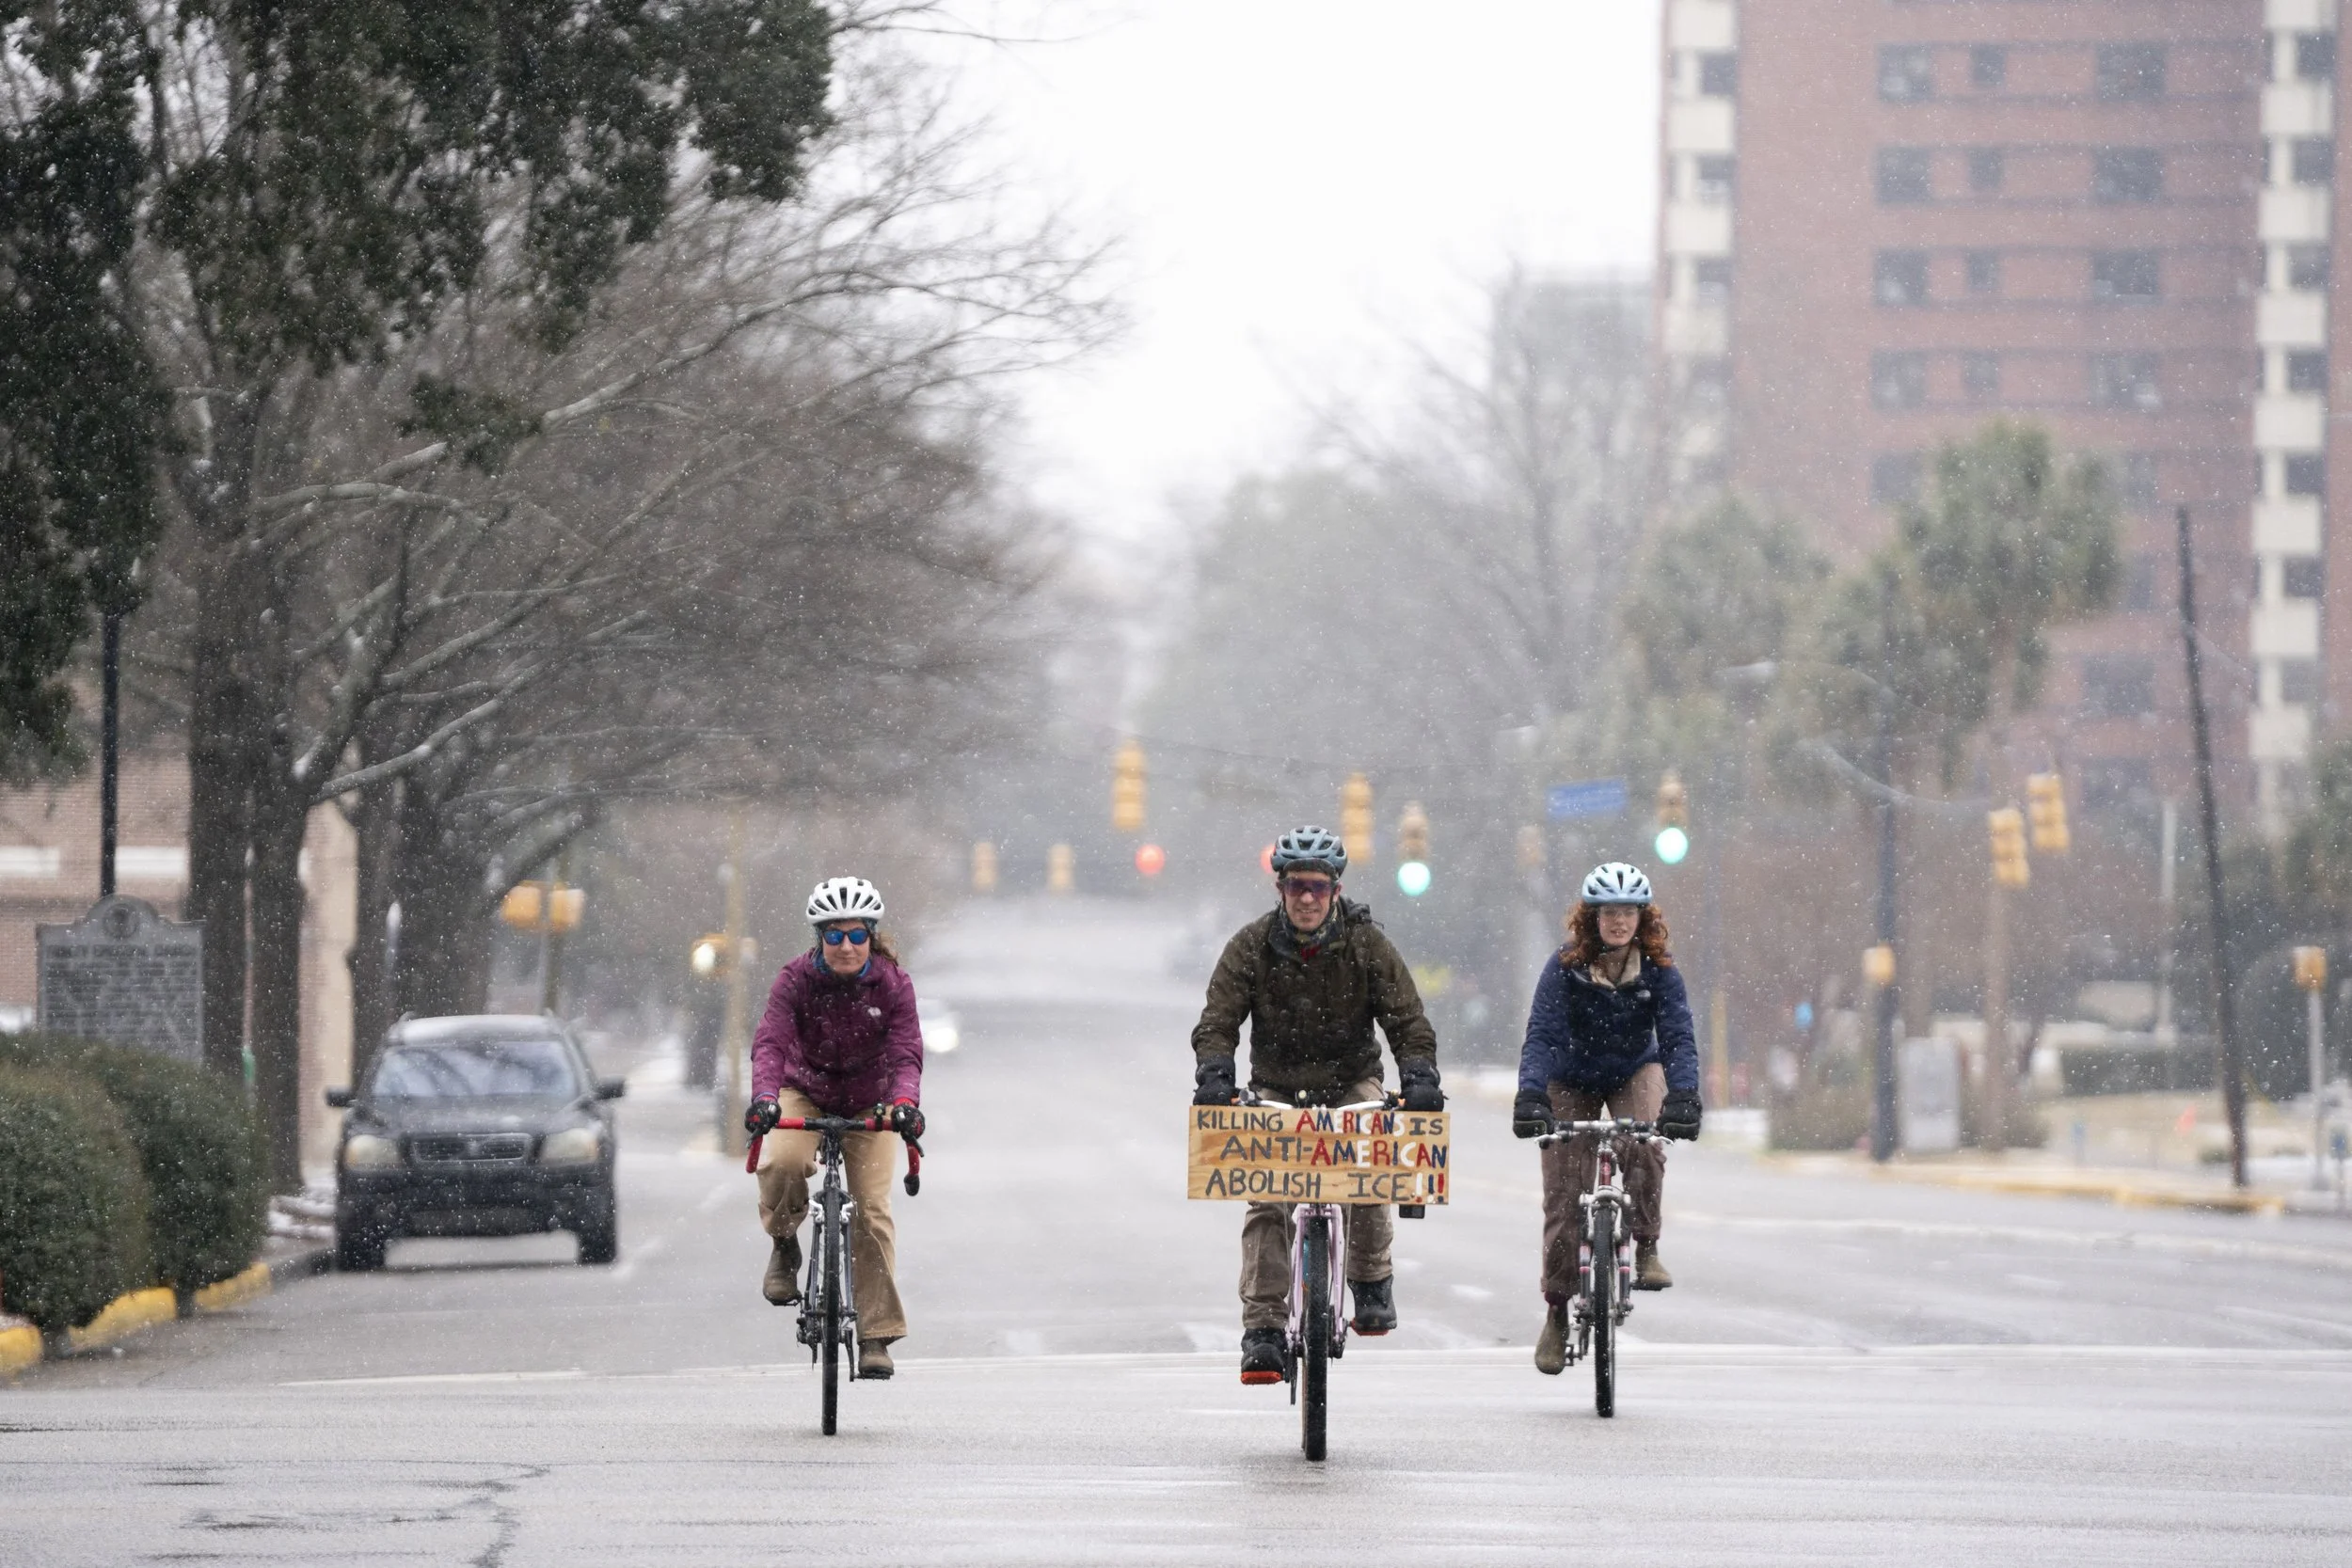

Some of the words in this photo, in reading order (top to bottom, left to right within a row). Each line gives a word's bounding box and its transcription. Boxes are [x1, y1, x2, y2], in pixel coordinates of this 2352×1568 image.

[1197, 1110, 1283, 1132] KILLING
[1295, 1110, 1405, 1136] AMERICANS
[1408, 1117, 1444, 1135] IS
[1220, 1135, 1447, 1168] ANTI-AMERICAN
[1206, 1169, 1321, 1199] ABOLISH
